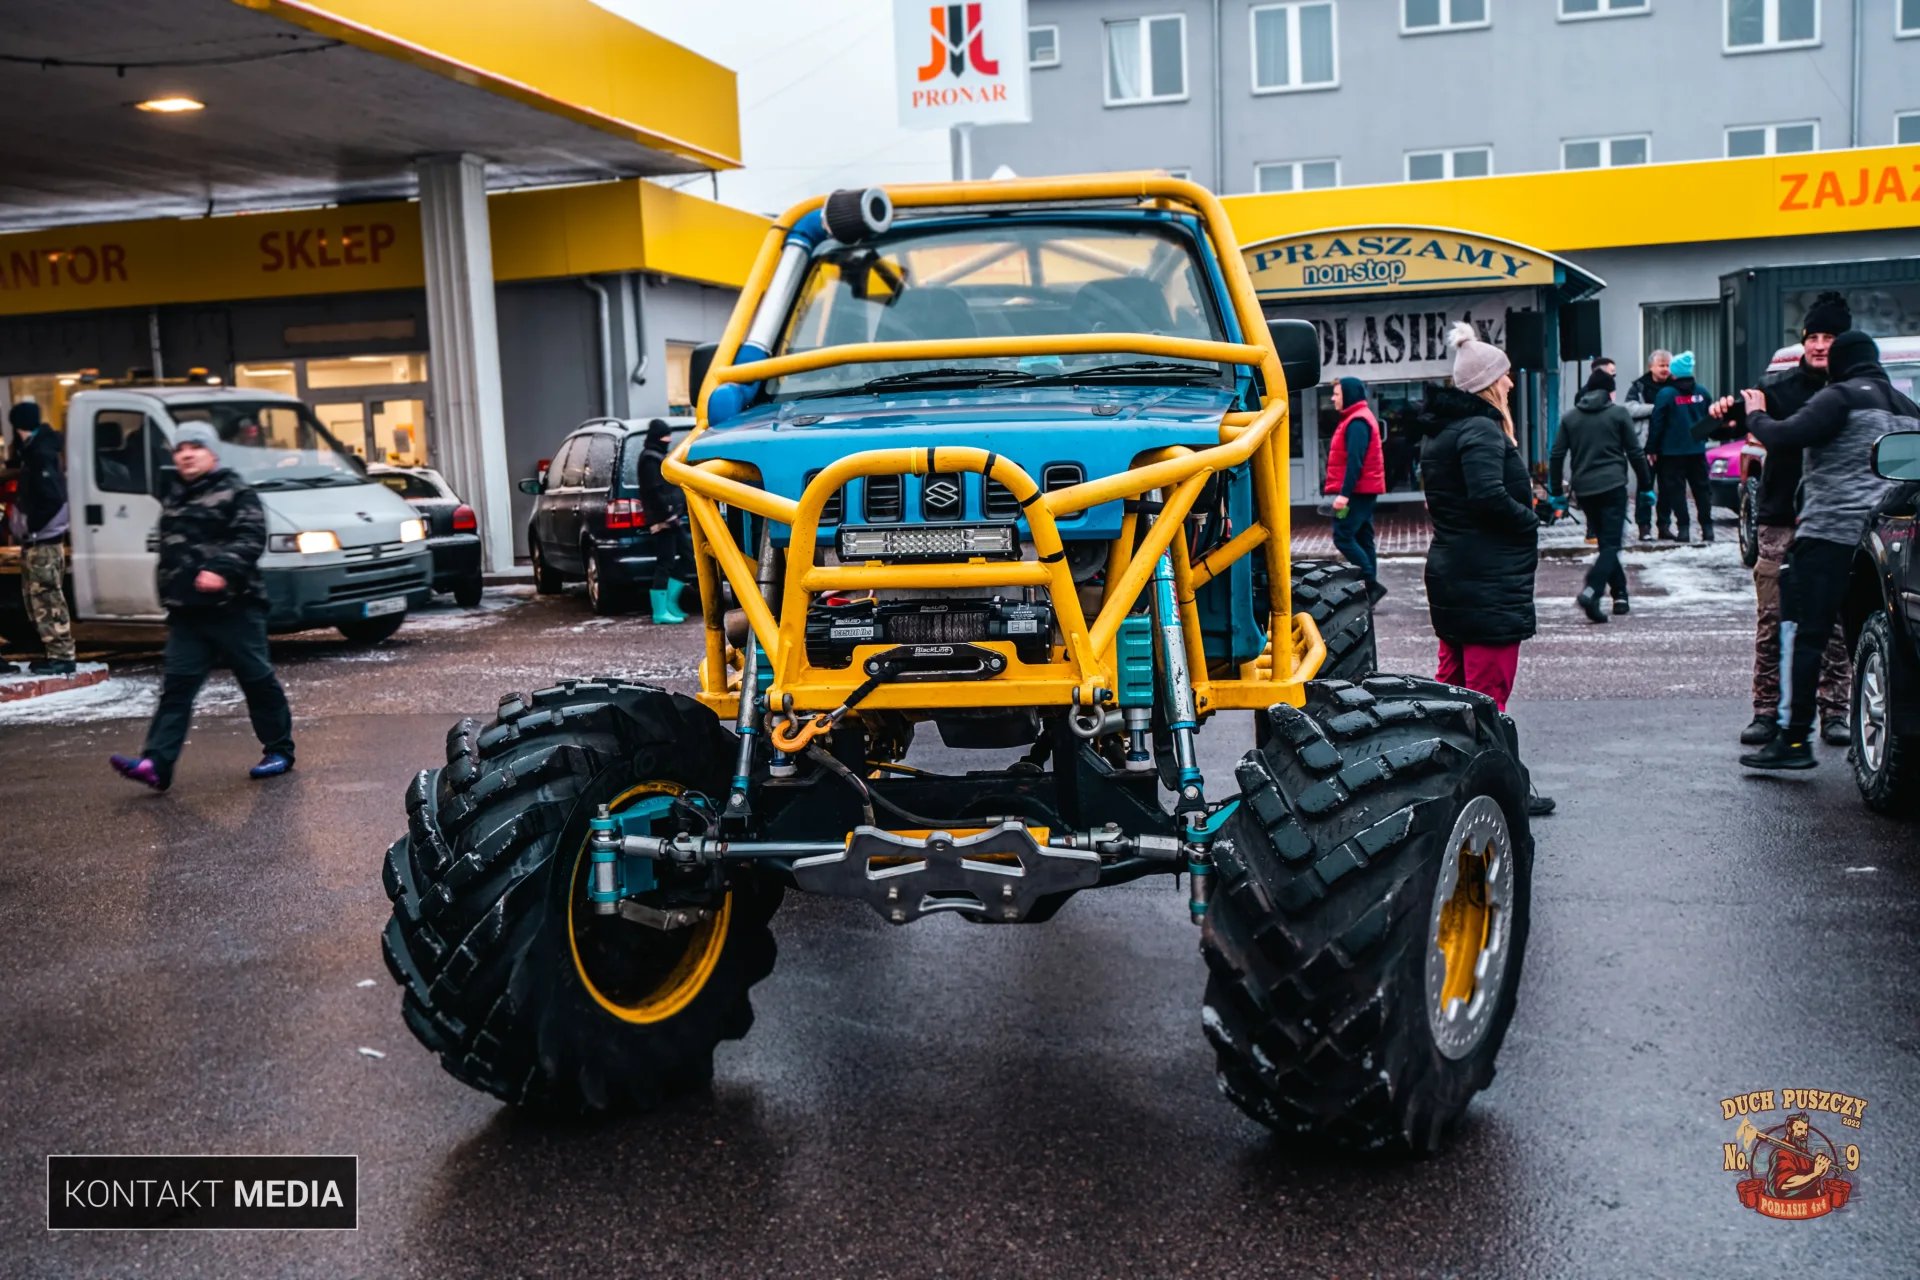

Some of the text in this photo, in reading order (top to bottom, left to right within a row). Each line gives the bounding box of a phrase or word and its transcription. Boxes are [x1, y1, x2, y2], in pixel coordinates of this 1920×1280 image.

[912, 84, 1007, 108] PRONAR
[0, 245, 128, 290] NTOR
[259, 223, 395, 272] SKLEP
[1249, 236, 1532, 278] PRASZAMY
[1303, 259, 1406, 284] non-stop
[1314, 311, 1447, 366] DLASIE
